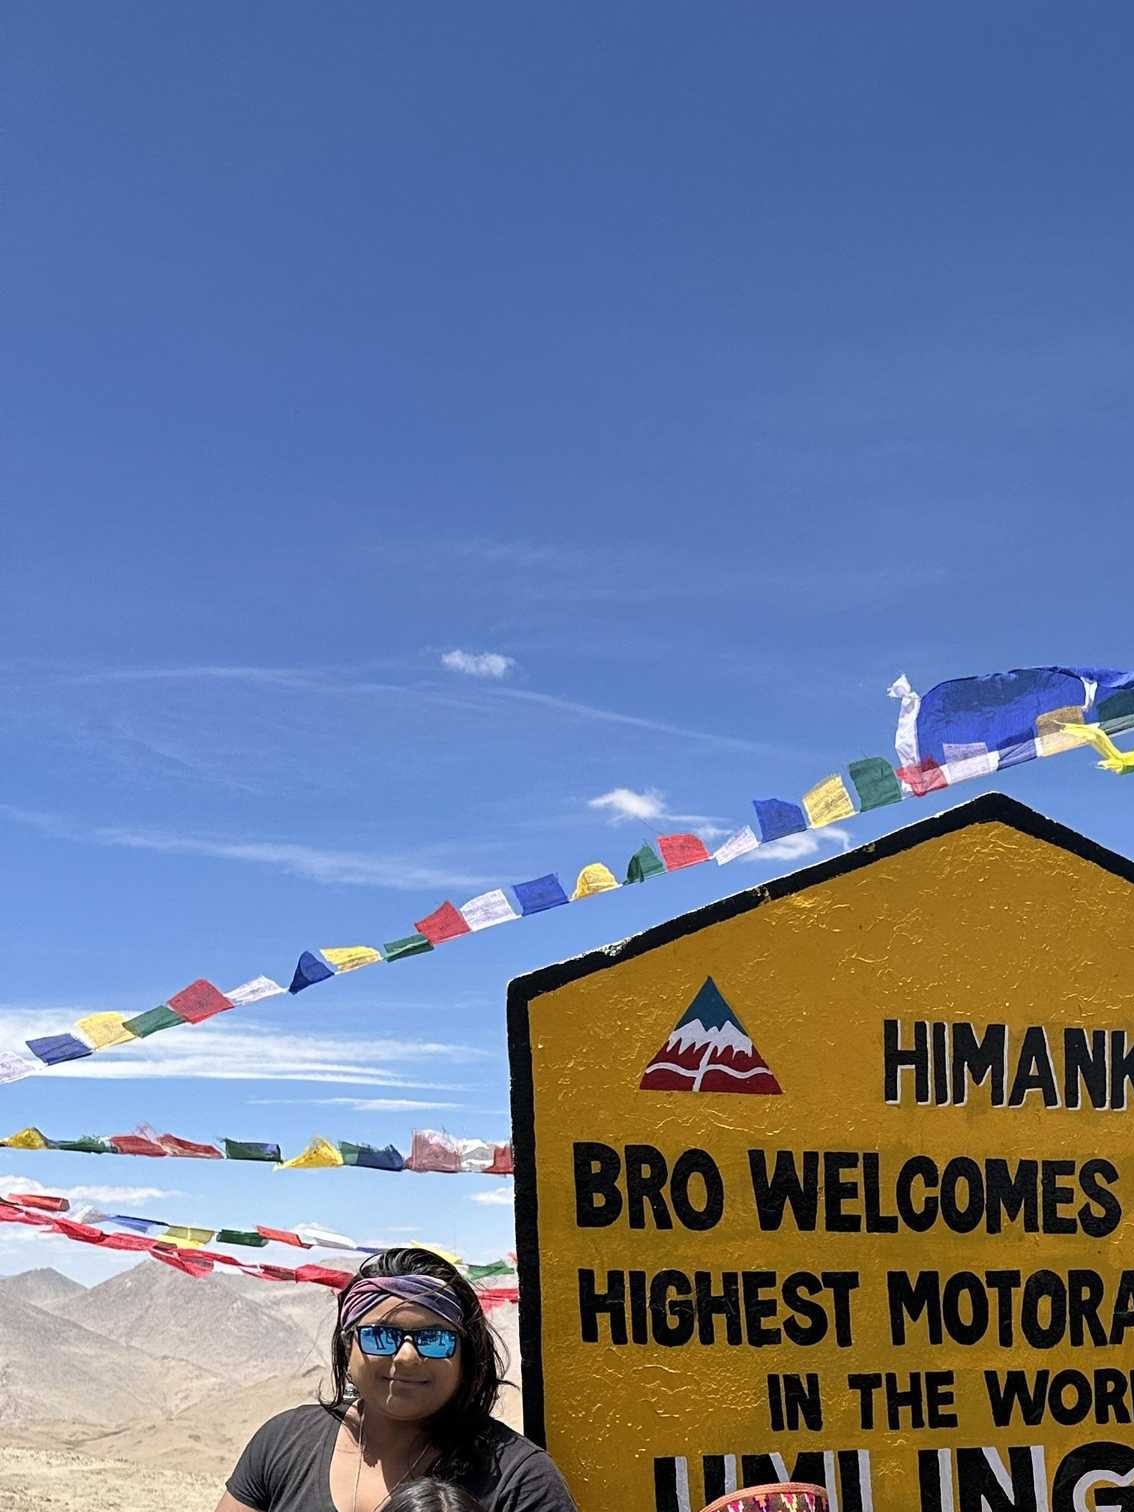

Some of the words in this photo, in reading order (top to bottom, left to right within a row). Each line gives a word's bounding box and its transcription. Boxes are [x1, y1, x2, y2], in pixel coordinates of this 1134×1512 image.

[573, 1141, 724, 1231] BRO
[748, 1148, 1122, 1239] WELCOMES
[578, 1268, 860, 1348] HIGHEST
[767, 1372, 824, 1432] IN
[847, 1369, 959, 1430] THE
